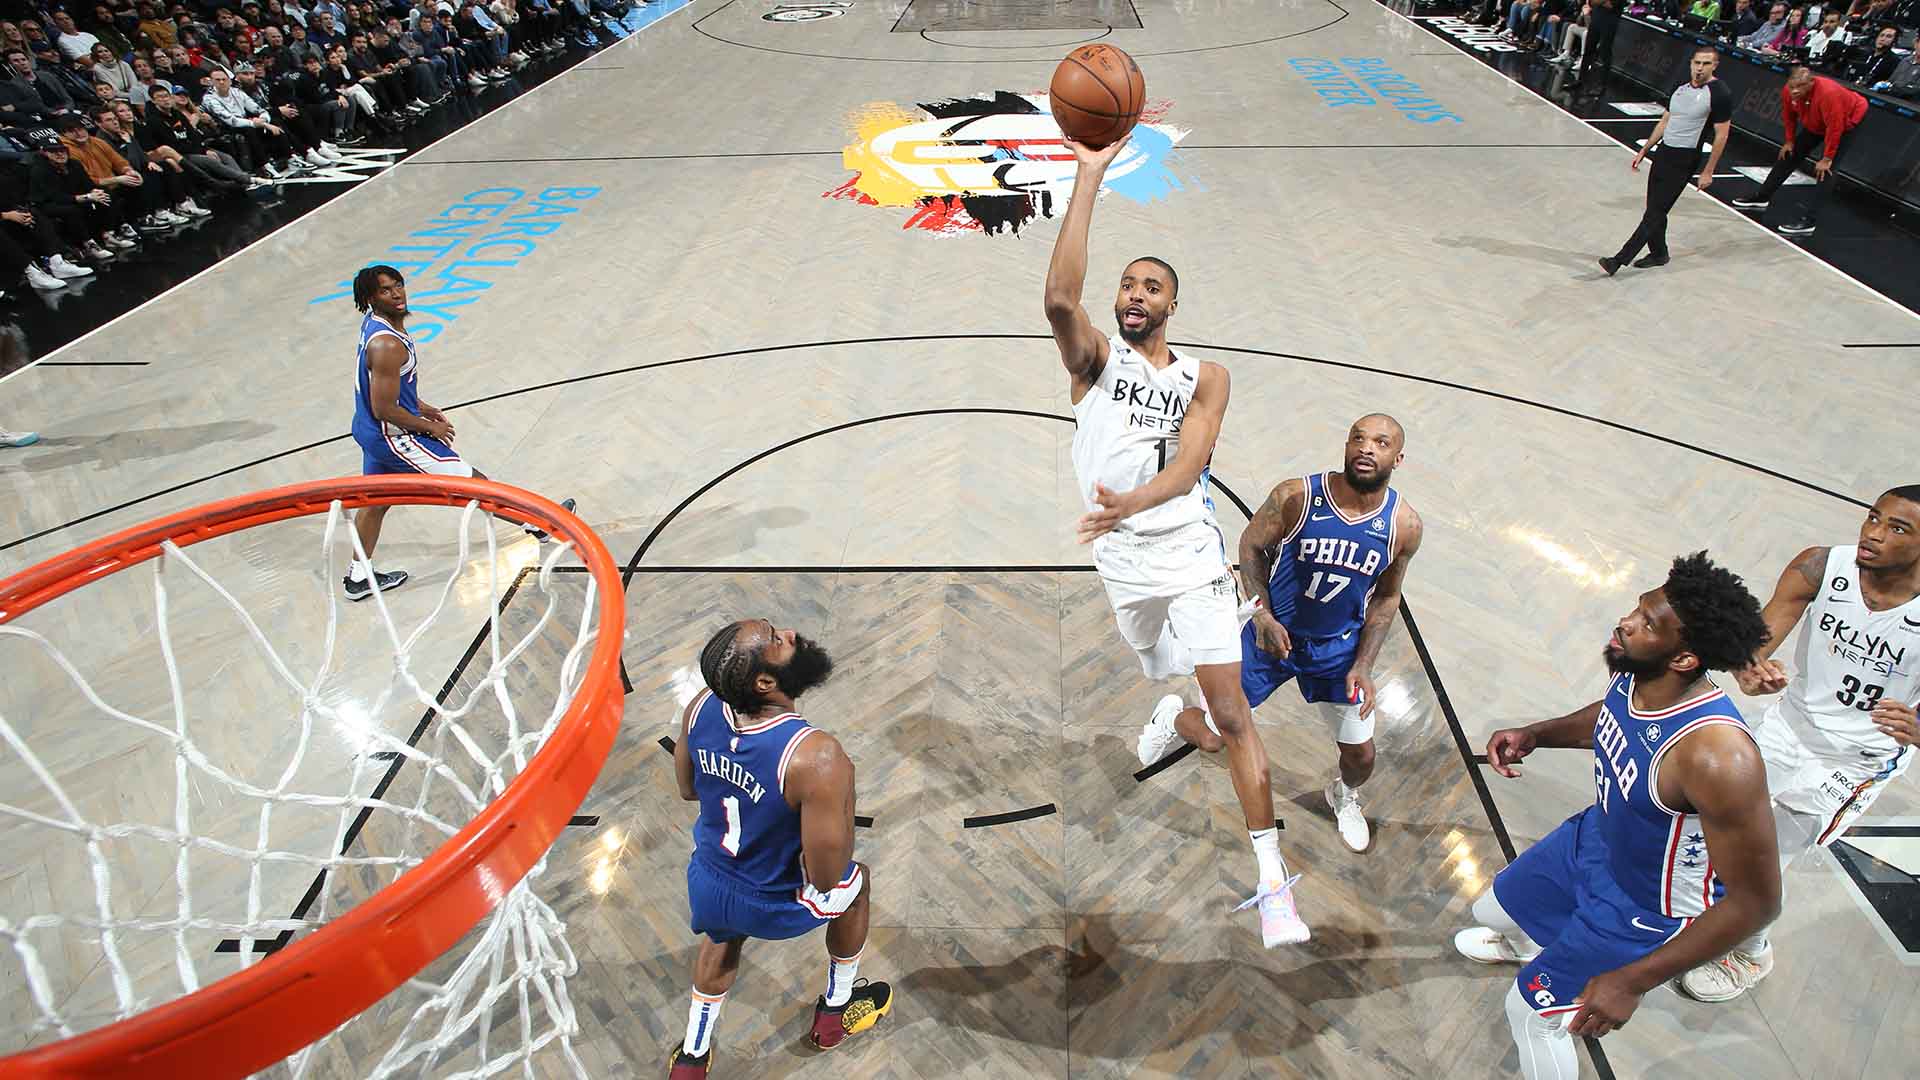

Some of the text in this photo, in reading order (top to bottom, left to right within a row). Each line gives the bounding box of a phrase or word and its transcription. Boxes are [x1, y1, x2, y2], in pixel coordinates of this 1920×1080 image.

[1287, 56, 1377, 107] CENTER
[1340, 56, 1464, 123] BARCLAYS
[405, 186, 603, 343] BARCLAYS
[1112, 379, 1187, 417] BKLYN
[1130, 413, 1183, 433] NETS
[1313, 496, 1323, 507] 6
[1298, 537, 1381, 576] PHILA
[1304, 571, 1352, 604] 17
[1833, 578, 1847, 590] 6
[1820, 613, 1905, 665] BKLYN
[1834, 645, 1893, 678] NETS
[1836, 674, 1884, 711] 33
[1597, 703, 1639, 802] PHILA
[697, 748, 766, 804] HARDEN
[720, 795, 741, 857] 1
